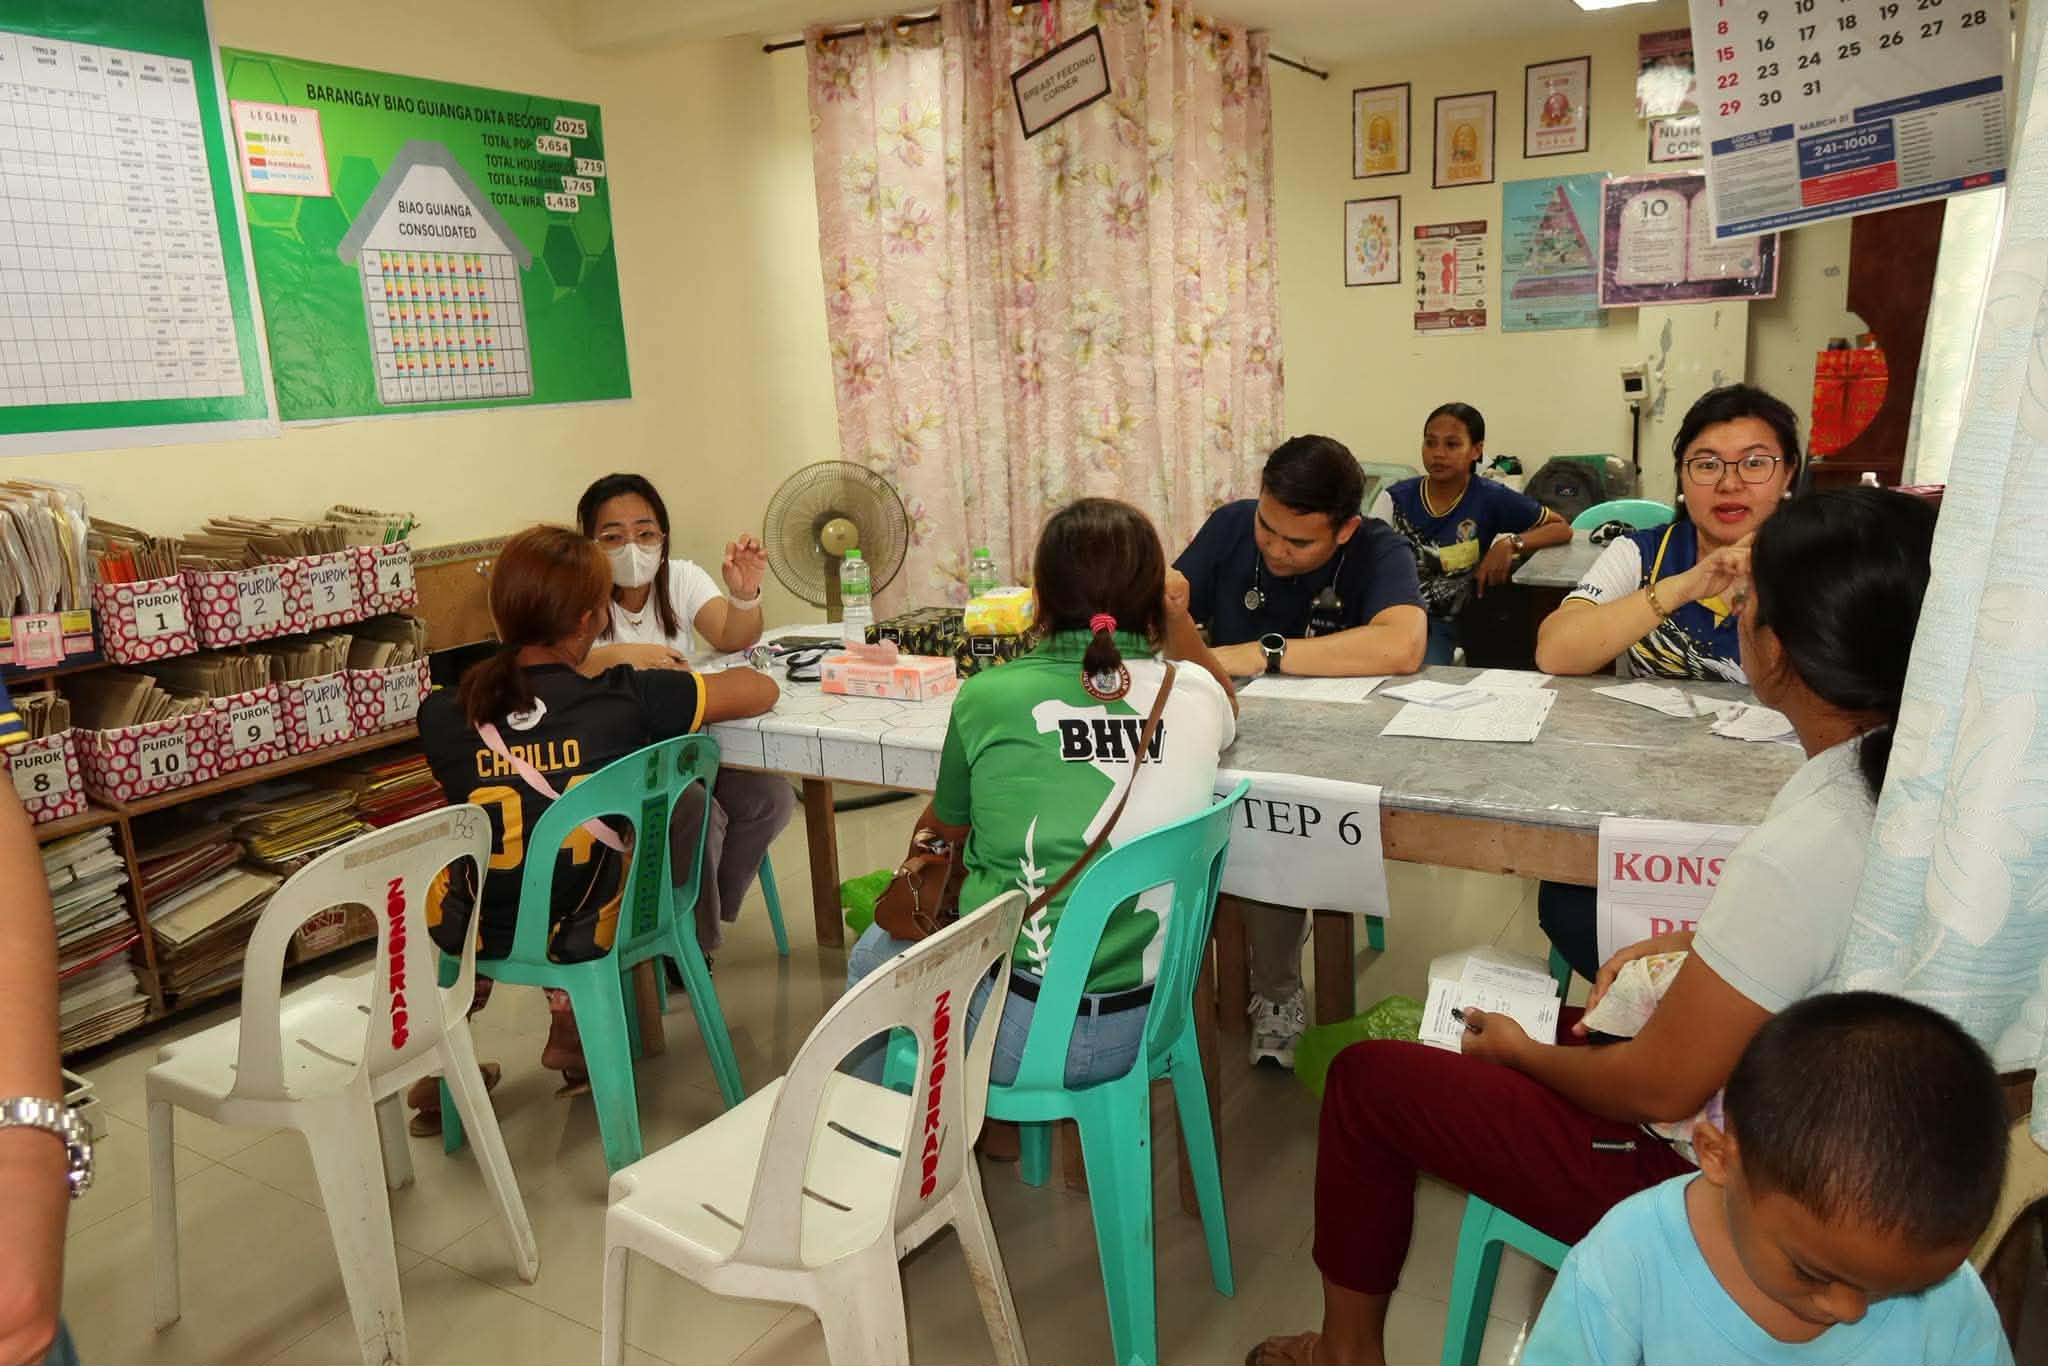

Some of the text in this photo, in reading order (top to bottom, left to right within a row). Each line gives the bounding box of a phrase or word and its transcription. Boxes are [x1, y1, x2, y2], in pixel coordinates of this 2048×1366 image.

[1717, 0, 1815, 35] 8 9 10
[1716, 47, 1735, 62] 15
[1756, 37, 1775, 53] 16
[1799, 25, 1817, 41] 17
[1837, 15, 1857, 31] 18
[1879, 3, 1899, 20] 19
[1717, 10, 1987, 90] 22 23 24 25 26 27 28
[1043, 75, 1080, 103] CORNER
[1719, 80, 1822, 117] 29 30 31
[306, 84, 586, 136] BARANGAY BIAO GUIANGA DATA RECORD 2025
[482, 133, 512, 149] TOTAL
[537, 138, 569, 153] 5,654
[1814, 134, 1878, 158] 241-1000
[486, 154, 515, 169] TOTAL
[488, 172, 517, 186] TOTAL
[398, 200, 473, 218] BIAO GUIANGA
[491, 192, 519, 207] TOTAL
[547, 195, 577, 209] 1,418
[398, 223, 477, 240] CONSOLIDATED
[379, 555, 408, 569] PUROK
[238, 576, 280, 598] PUROK
[310, 567, 348, 588] PUROK
[390, 571, 401, 589] 4
[136, 592, 180, 609] PUROK
[323, 585, 336, 603] 3
[253, 598, 267, 616] 2
[155, 612, 169, 631] 1
[384, 673, 417, 693] PUROK
[303, 682, 345, 706] PUROK
[393, 692, 412, 713] 12
[232, 705, 270, 722] PUROK
[315, 705, 335, 726] 11
[142, 735, 186, 753] PUROK
[247, 725, 261, 743] 9
[1058, 718, 1167, 763] BHW
[14, 751, 63, 770] PUROK
[150, 753, 180, 777] 10
[33, 773, 50, 793] 8
[1338, 810, 1362, 846] 6
[1613, 852, 1727, 887] KONS
